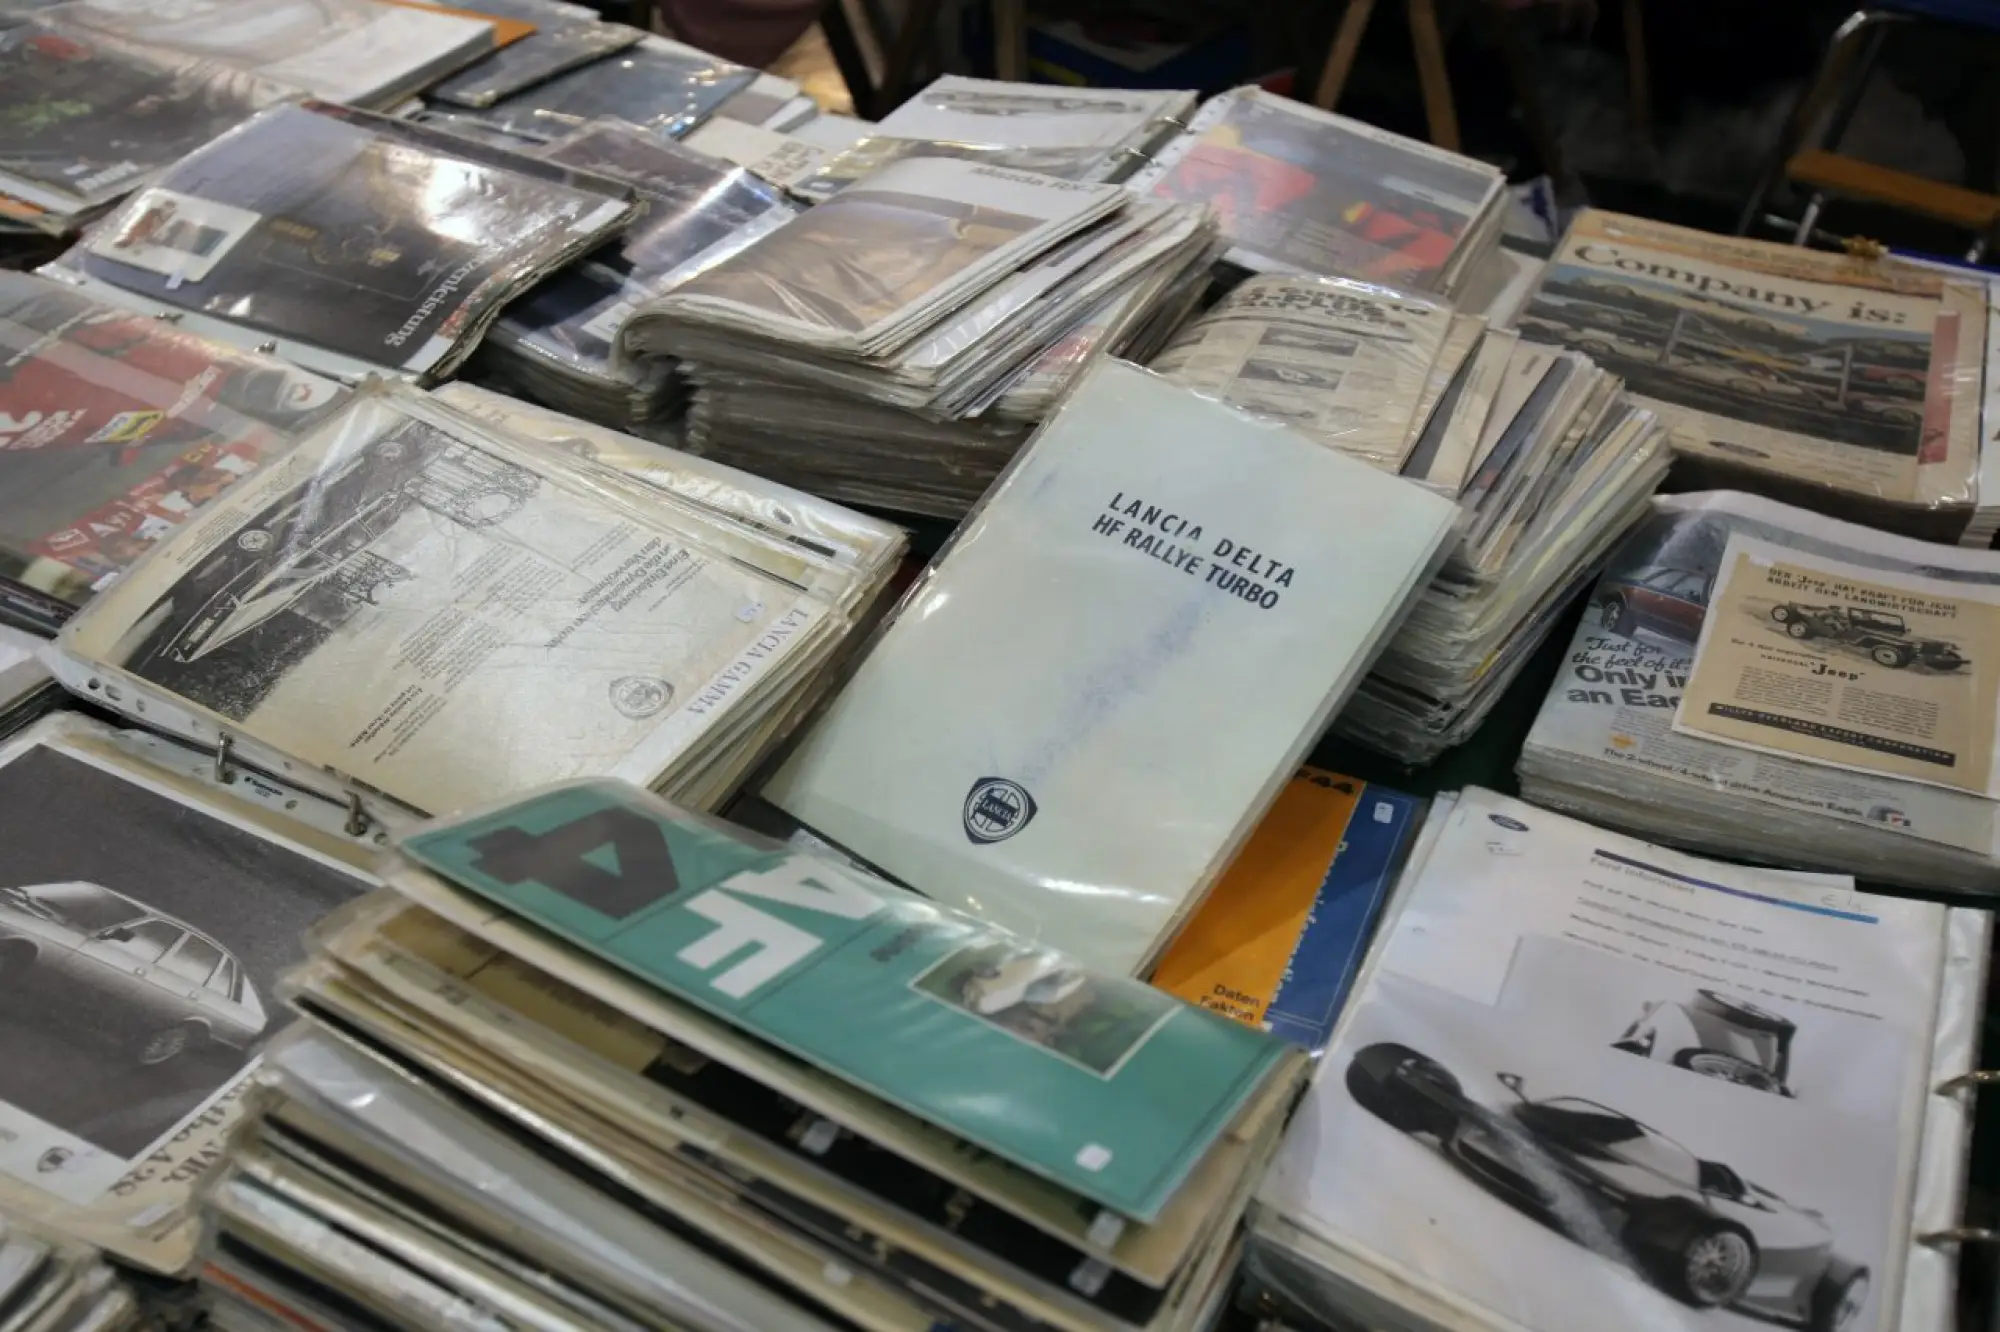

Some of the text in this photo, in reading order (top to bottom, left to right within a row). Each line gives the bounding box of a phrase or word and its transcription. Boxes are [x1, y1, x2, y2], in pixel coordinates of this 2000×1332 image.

[1573, 244, 1832, 315] Company
[1848, 302, 1908, 327] is:
[1091, 513, 1280, 610] HF RALLYE TURBO
[1108, 491, 1295, 589] LANCIA DELTA
[745, 607, 809, 659] LANCIA
[687, 661, 752, 714] GAMMA
[1572, 651, 1601, 665] the
[1644, 656, 1665, 672] of
[1574, 664, 1657, 690] Only
[1566, 688, 1614, 706] an
[1214, 984, 1260, 1008] Daten
